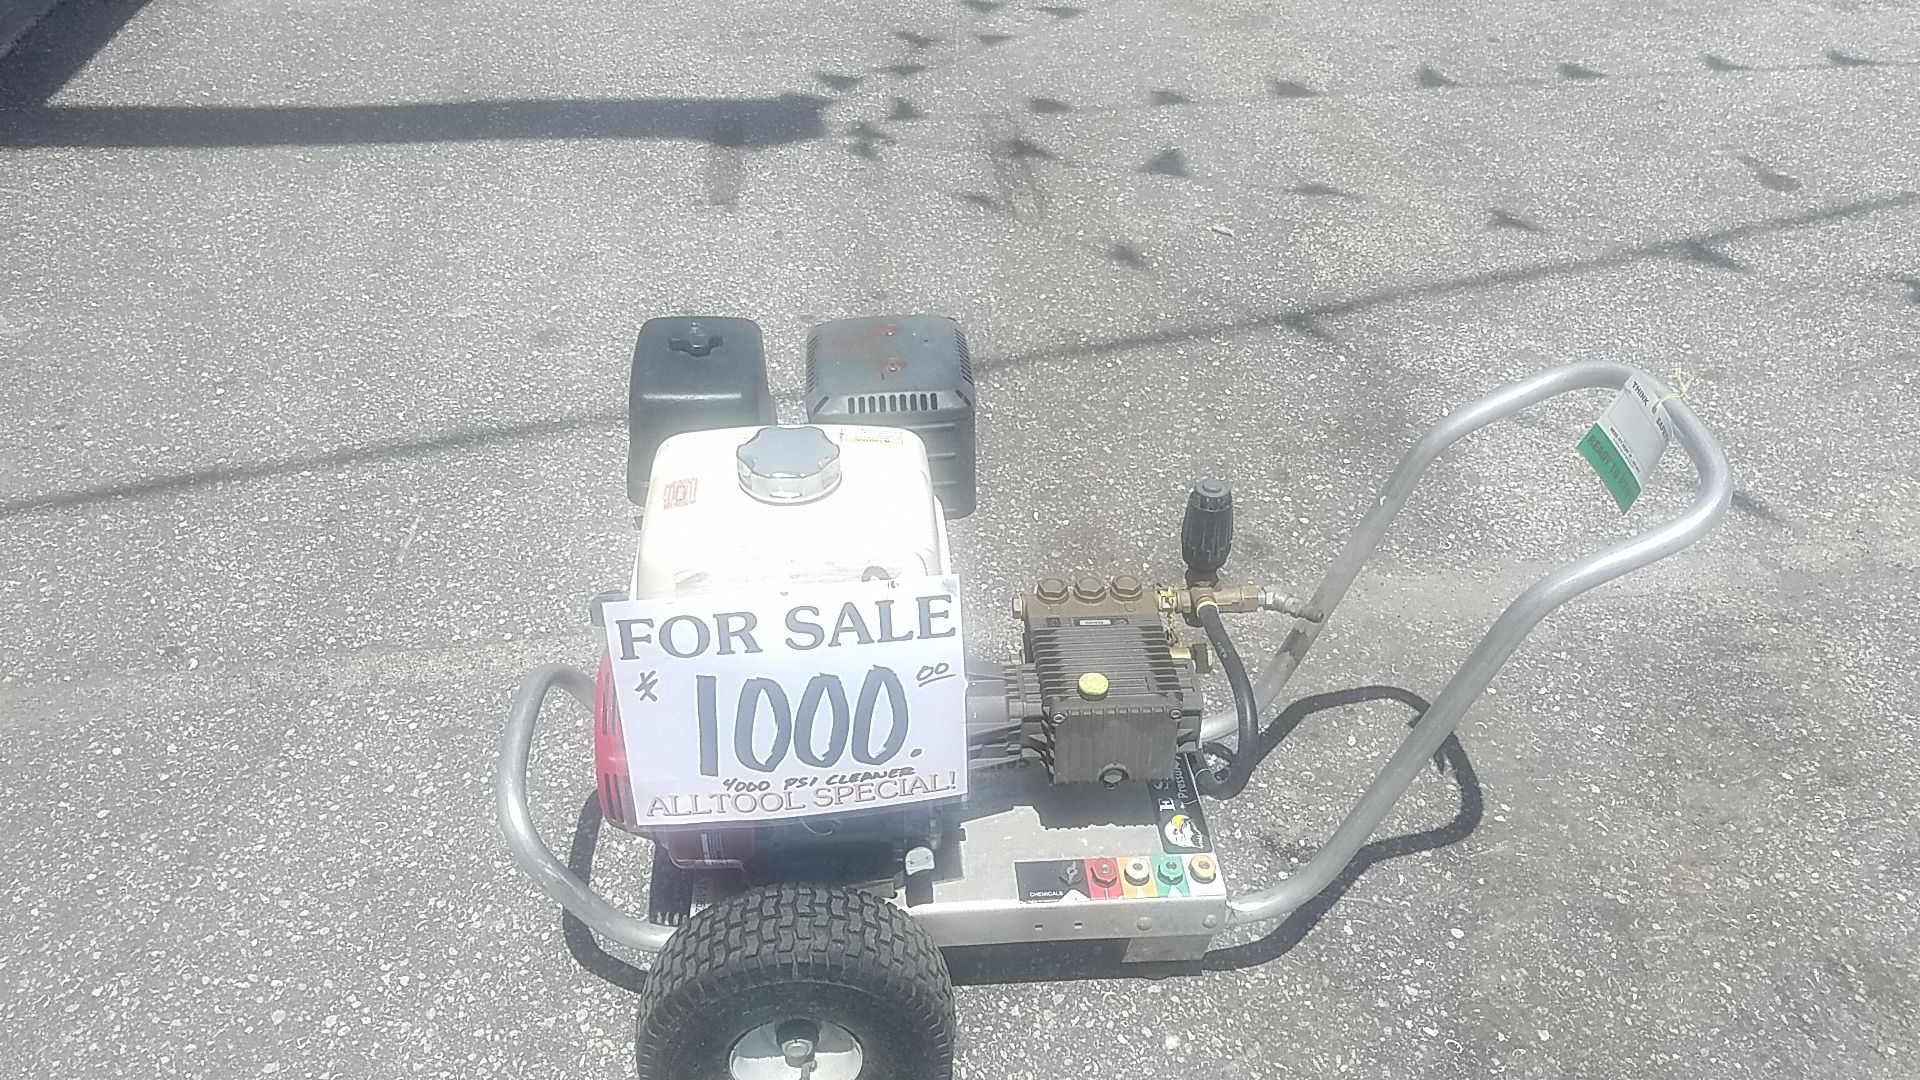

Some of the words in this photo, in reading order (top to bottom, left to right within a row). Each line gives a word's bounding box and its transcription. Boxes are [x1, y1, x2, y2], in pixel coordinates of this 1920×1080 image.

[1631, 380, 1650, 406] THINK
[616, 612, 763, 660] FOR
[785, 595, 956, 650] SALE
[646, 792, 805, 817] ALLTOOL
[813, 771, 956, 807] SPECIAL!
[723, 777, 770, 792] 4000
[784, 776, 818, 790] PSI
[826, 767, 915, 786] CLEANER
